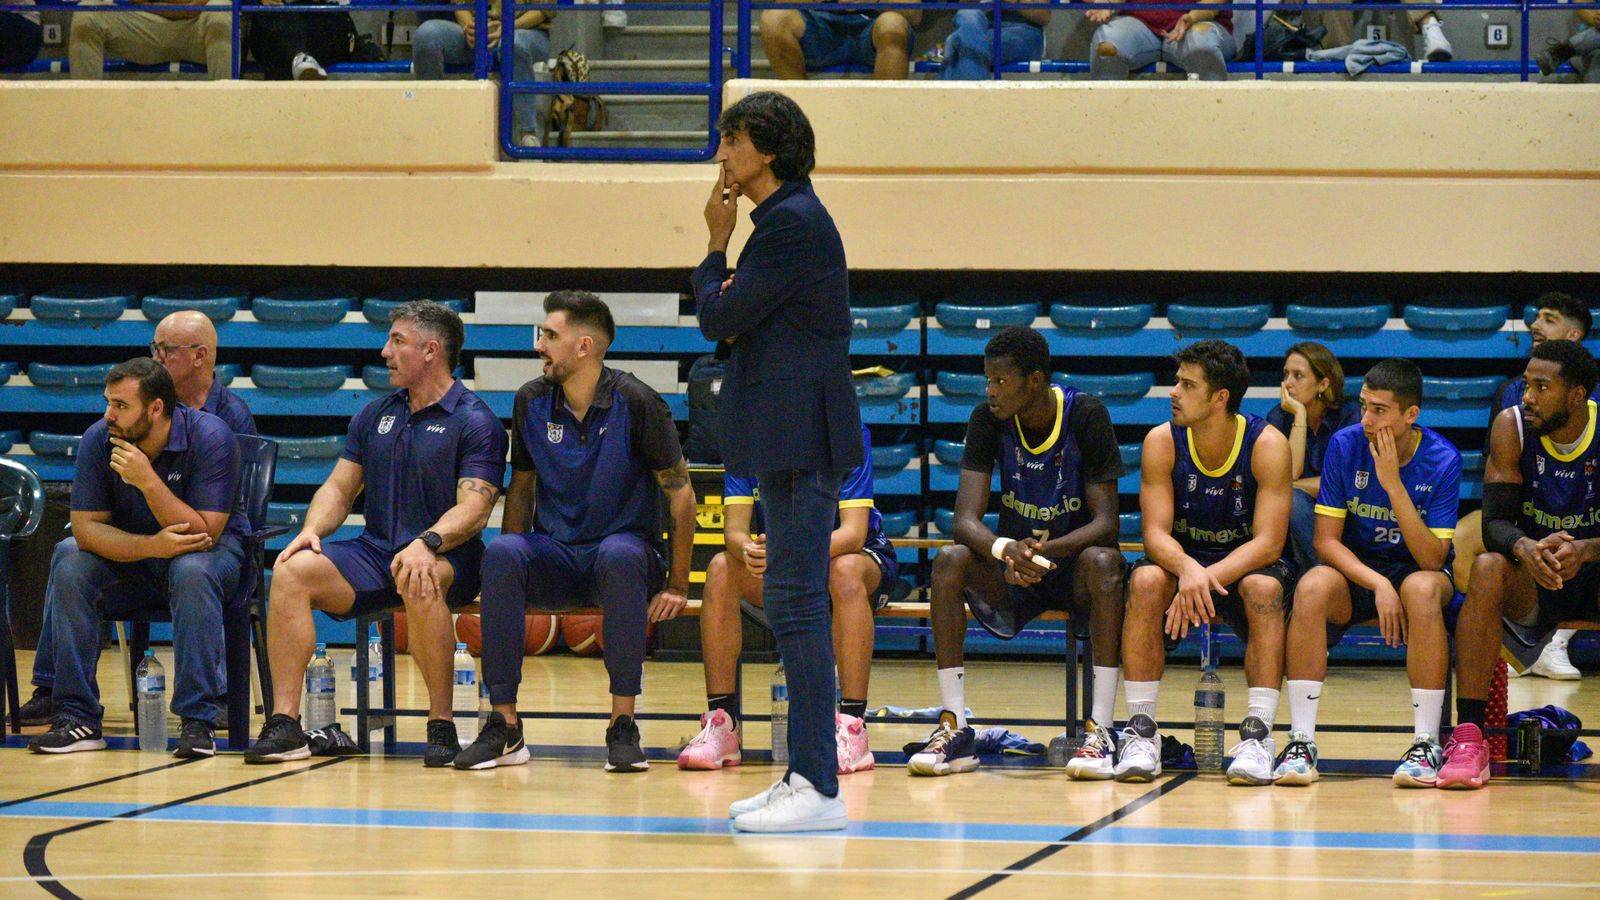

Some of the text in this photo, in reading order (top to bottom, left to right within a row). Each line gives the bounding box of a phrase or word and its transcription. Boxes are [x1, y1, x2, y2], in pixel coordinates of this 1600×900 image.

[1494, 28, 1503, 41] 6
[167, 470, 182, 481] viv
[1554, 469, 1576, 479] vive
[1204, 486, 1225, 497] vive
[1415, 482, 1433, 493] vive
[1001, 490, 1082, 522] damex.io
[1031, 528, 1050, 545] 7
[1374, 526, 1401, 545] 26
